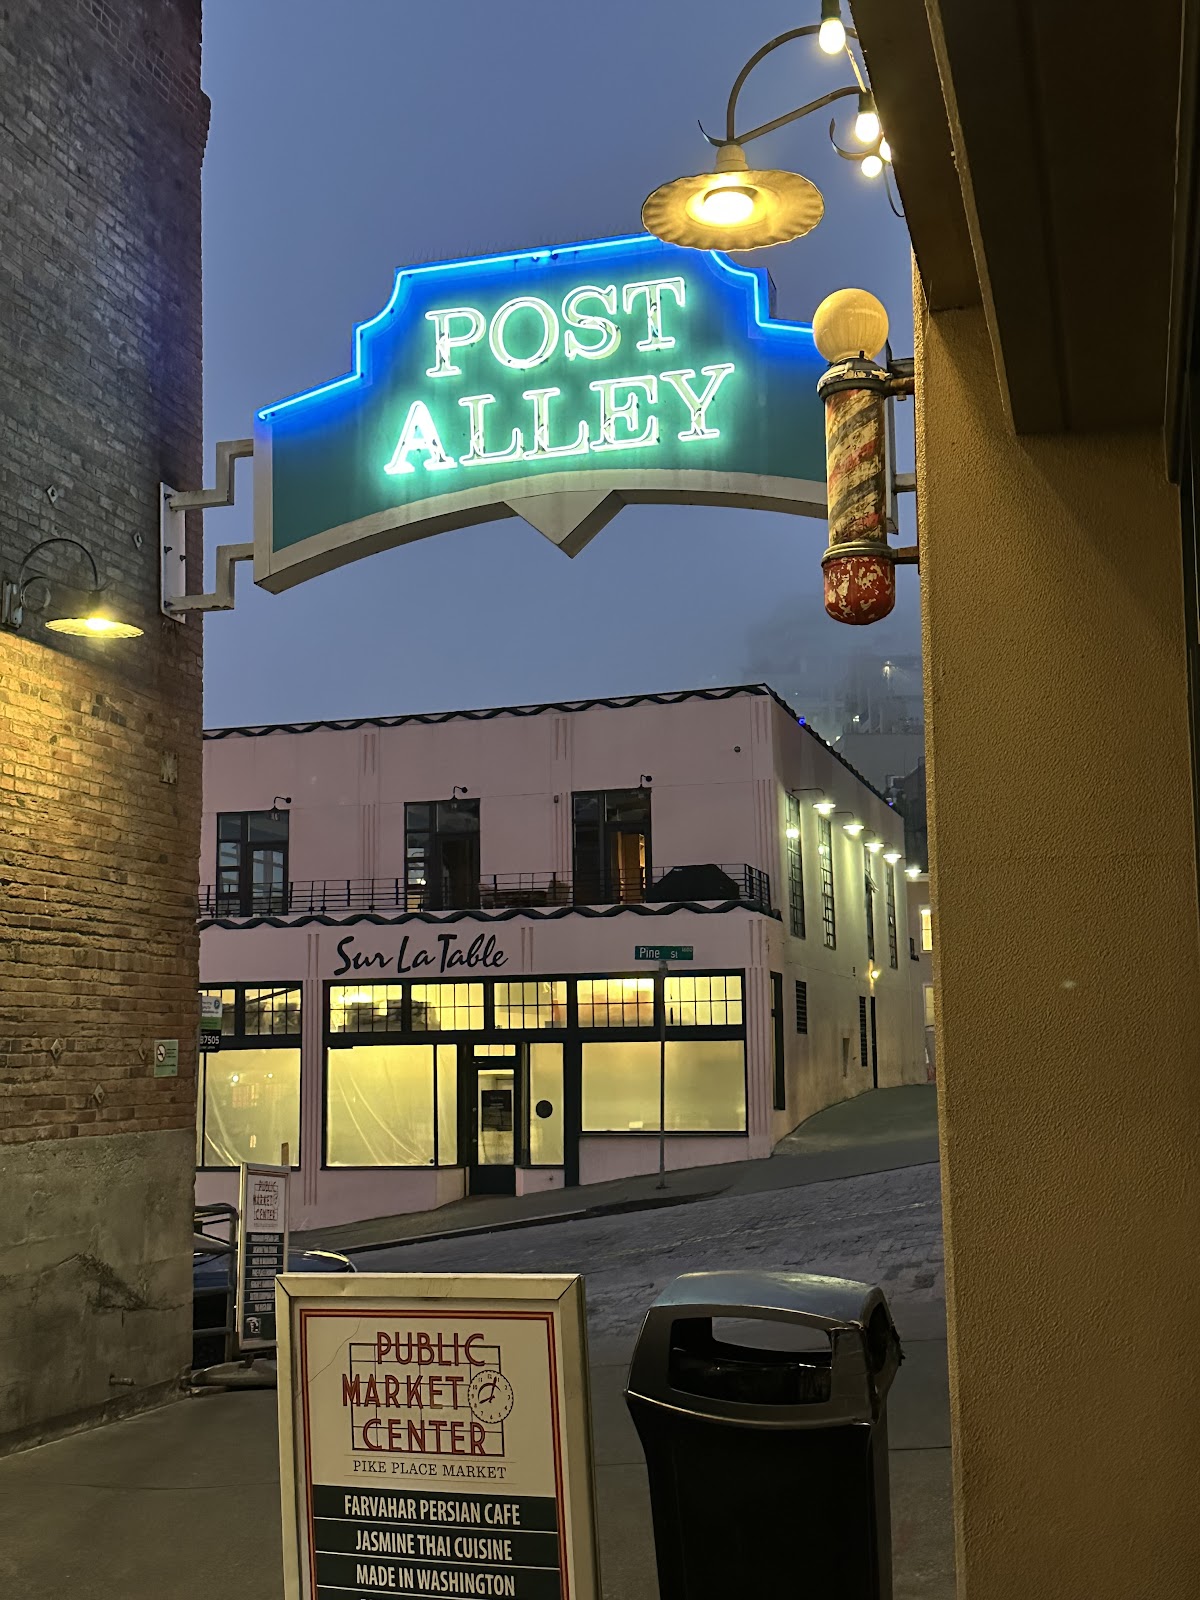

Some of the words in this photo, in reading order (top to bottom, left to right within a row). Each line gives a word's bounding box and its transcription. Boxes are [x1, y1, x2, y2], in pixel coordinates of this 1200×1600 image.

[425, 276, 686, 378] POST
[384, 362, 735, 475] ALLEY
[333, 935, 394, 976] Sur
[397, 935, 436, 974] La
[437, 933, 509, 974] Table
[640, 947, 660, 958] Pine
[670, 950, 678, 958] St
[376, 1331, 486, 1367] PUBLIC
[341, 1373, 465, 1411] MARKET
[362, 1418, 487, 1455] CENTER
[353, 1460, 387, 1473] PIKE
[391, 1462, 438, 1476] PLACE
[442, 1464, 507, 1479] MARKET
[344, 1494, 417, 1520] FARVAHAR
[419, 1499, 481, 1524] PERSIAN
[484, 1503, 521, 1526] CAFE
[355, 1529, 415, 1555] JASMINE
[416, 1534, 451, 1557] THAI
[454, 1537, 513, 1561] CUISINE
[356, 1563, 396, 1587] MADE
[399, 1567, 414, 1589] IN
[416, 1568, 516, 1597] WASHINGTON
